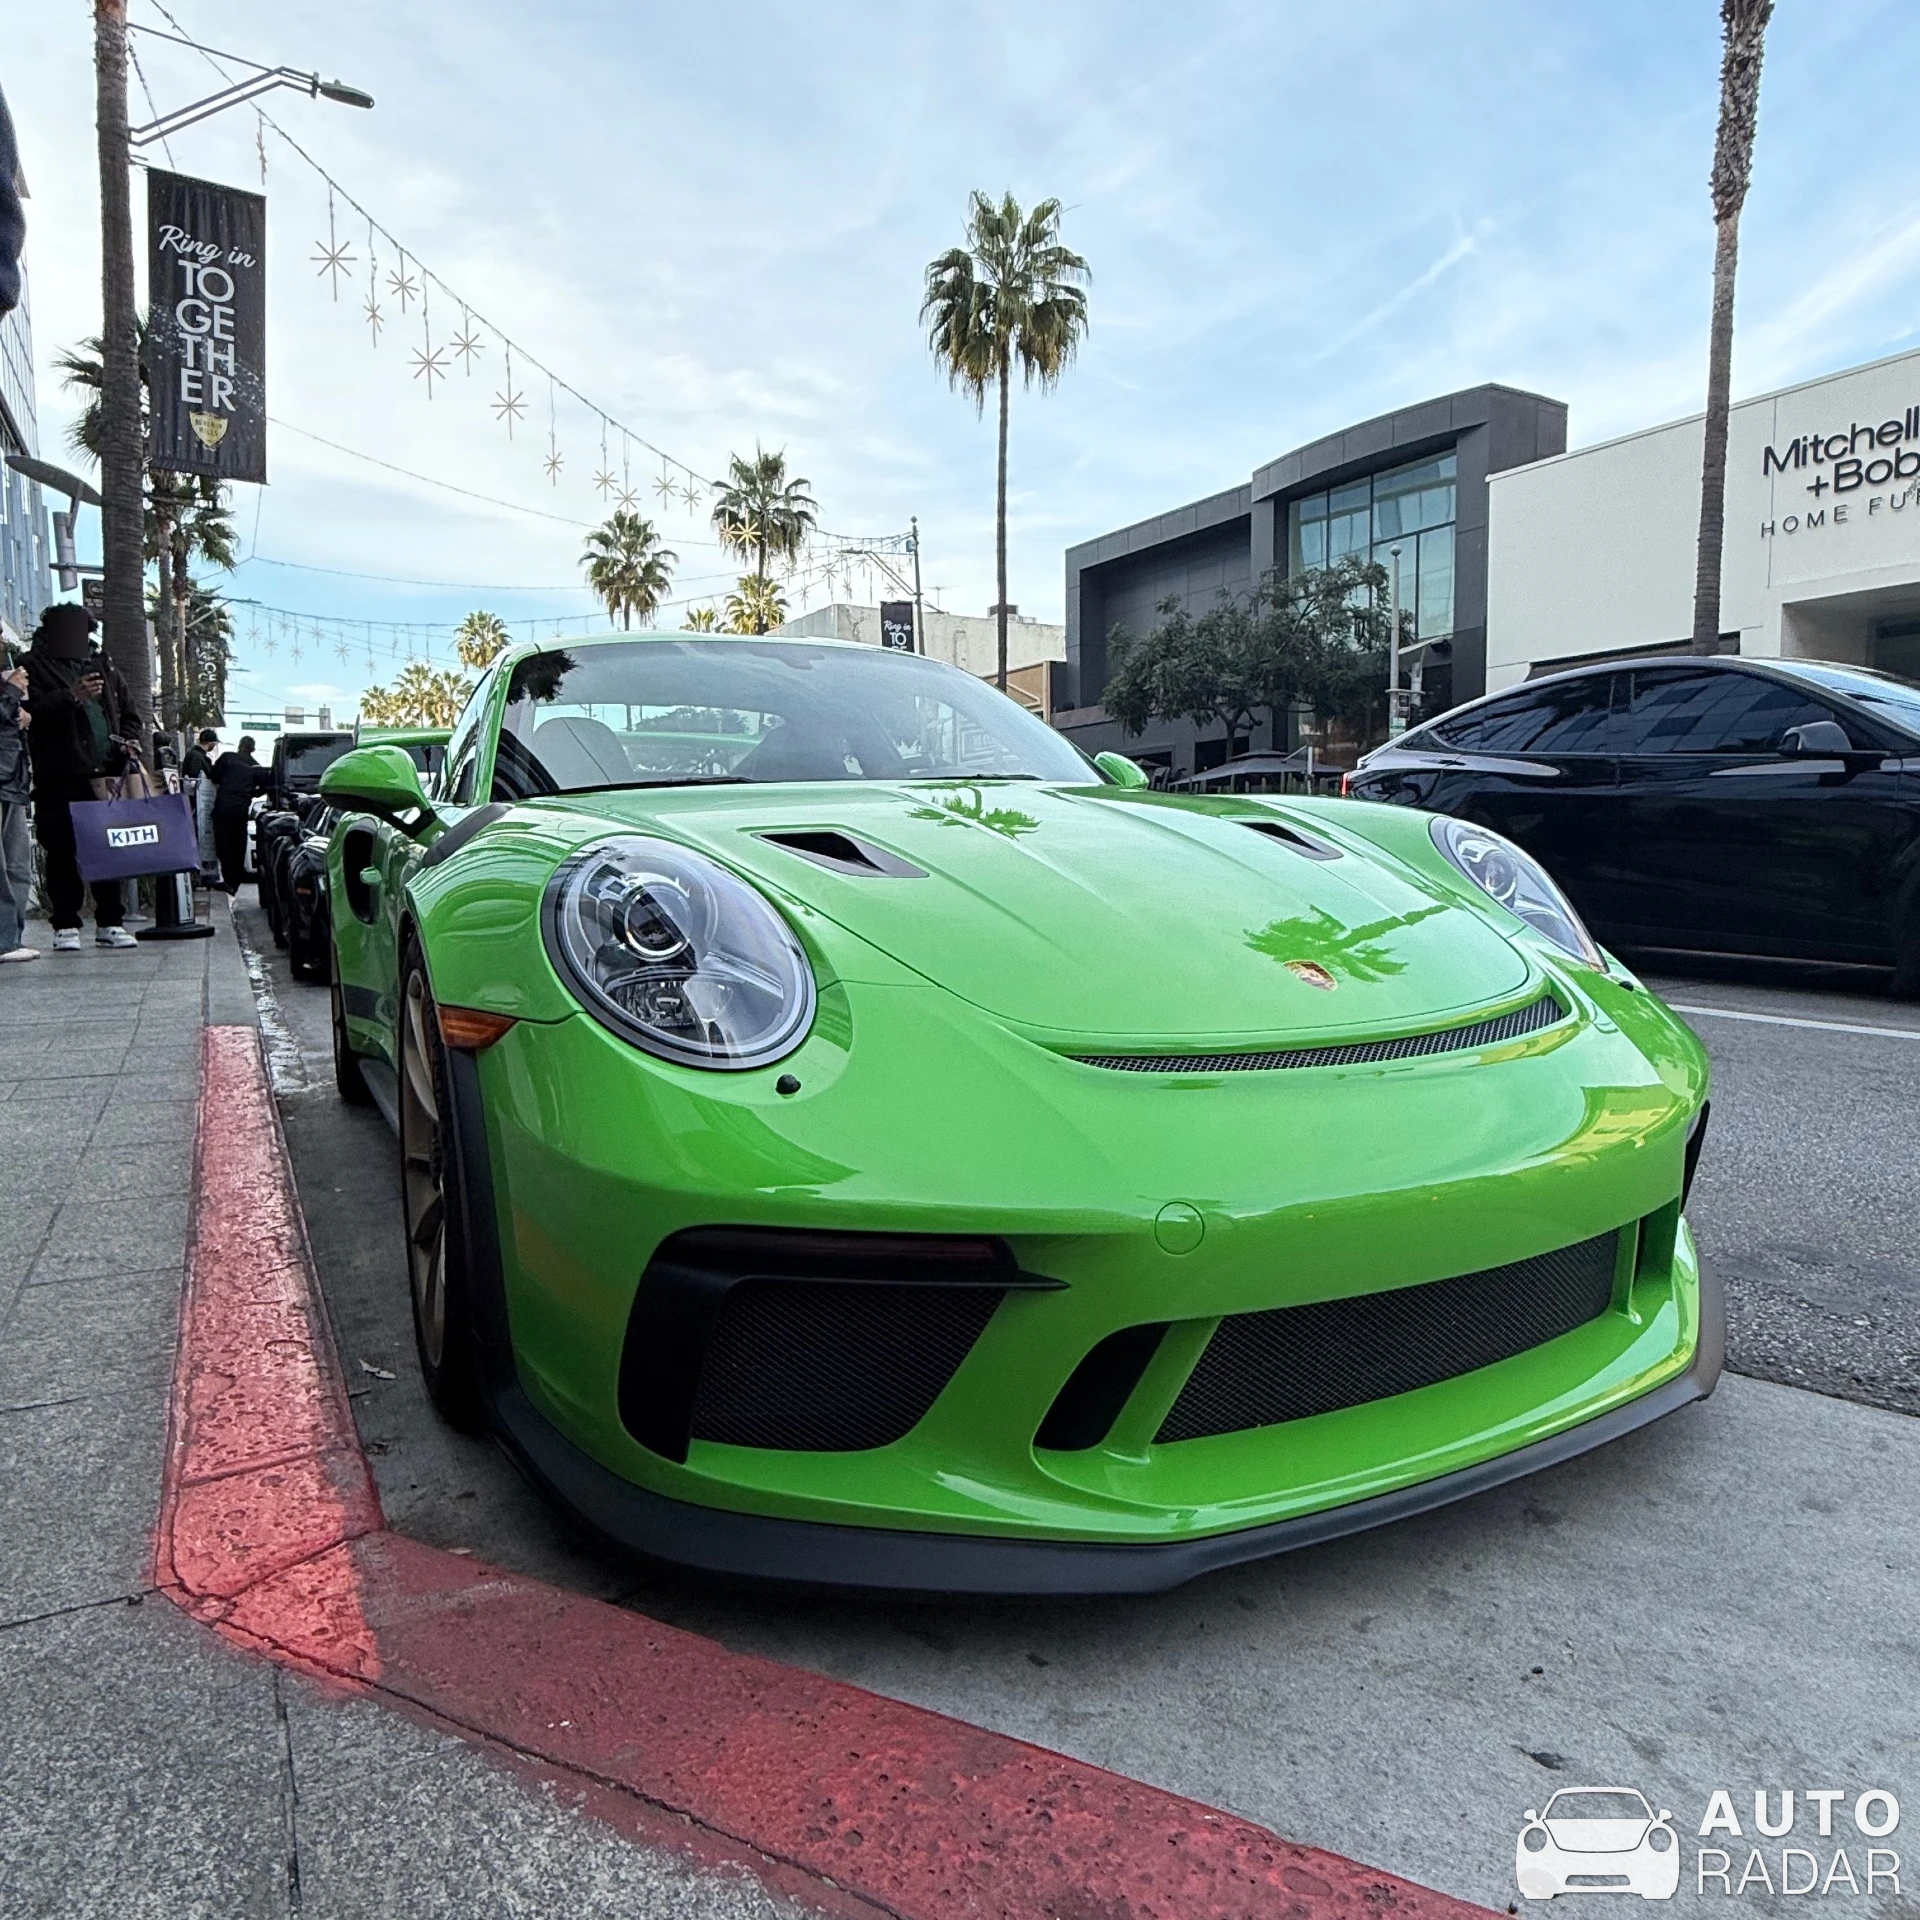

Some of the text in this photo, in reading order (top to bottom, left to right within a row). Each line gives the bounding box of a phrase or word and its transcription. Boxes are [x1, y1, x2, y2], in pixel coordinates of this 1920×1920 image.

[158, 224, 256, 268] Ring in
[178, 259, 235, 302] TO
[175, 298, 235, 342] GE
[178, 332, 235, 377] TH
[180, 367, 237, 412] ER
[1763, 405, 1920, 476] Mitchell
[1761, 504, 1849, 538] HOME
[883, 619, 912, 632] Ring in
[889, 631, 907, 646] TO
[111, 827, 155, 844] KITH
